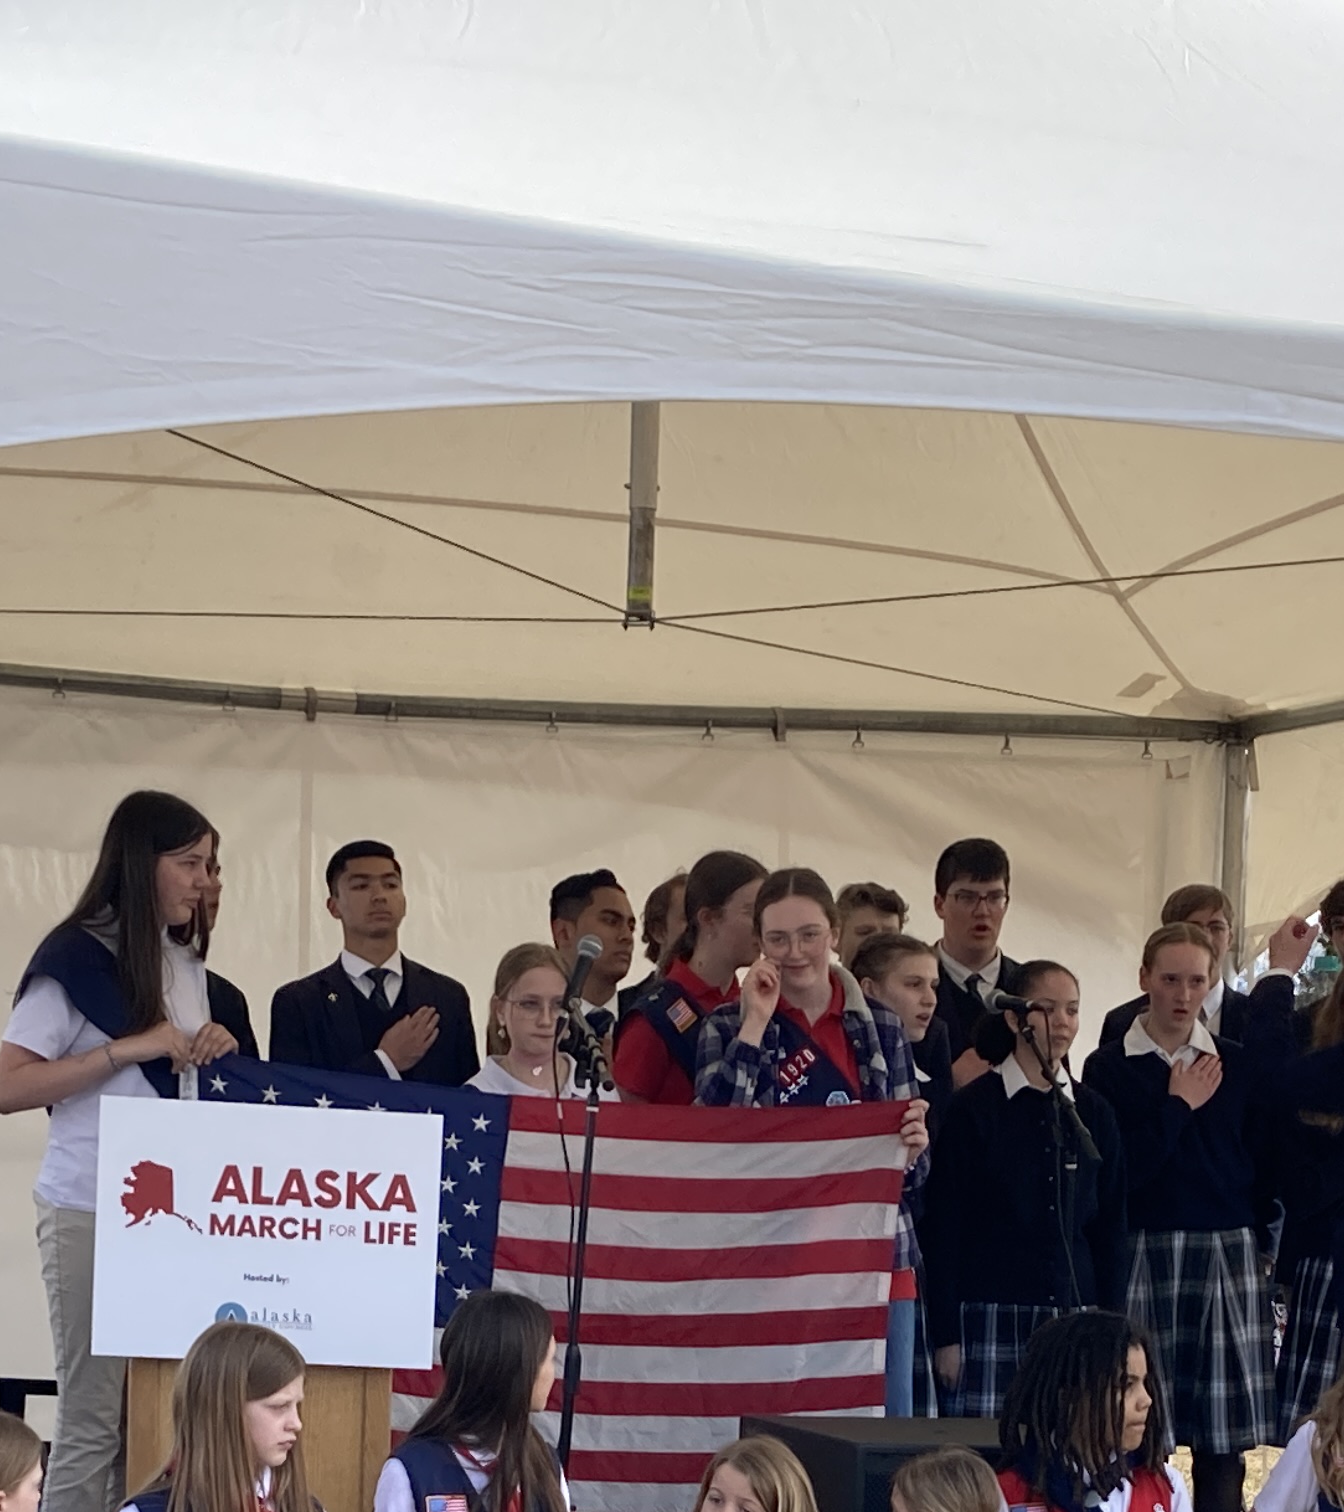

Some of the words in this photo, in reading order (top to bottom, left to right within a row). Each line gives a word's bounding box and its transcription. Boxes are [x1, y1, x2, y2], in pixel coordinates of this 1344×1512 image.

[780, 1048, 816, 1083] 1920
[211, 1164, 417, 1213] ALASKA
[209, 1213, 322, 1241] MARCH
[329, 1224, 356, 1237] FOR
[363, 1221, 417, 1246] LIFE
[243, 1273, 274, 1282] Hosted
[250, 1307, 312, 1323] alaska
